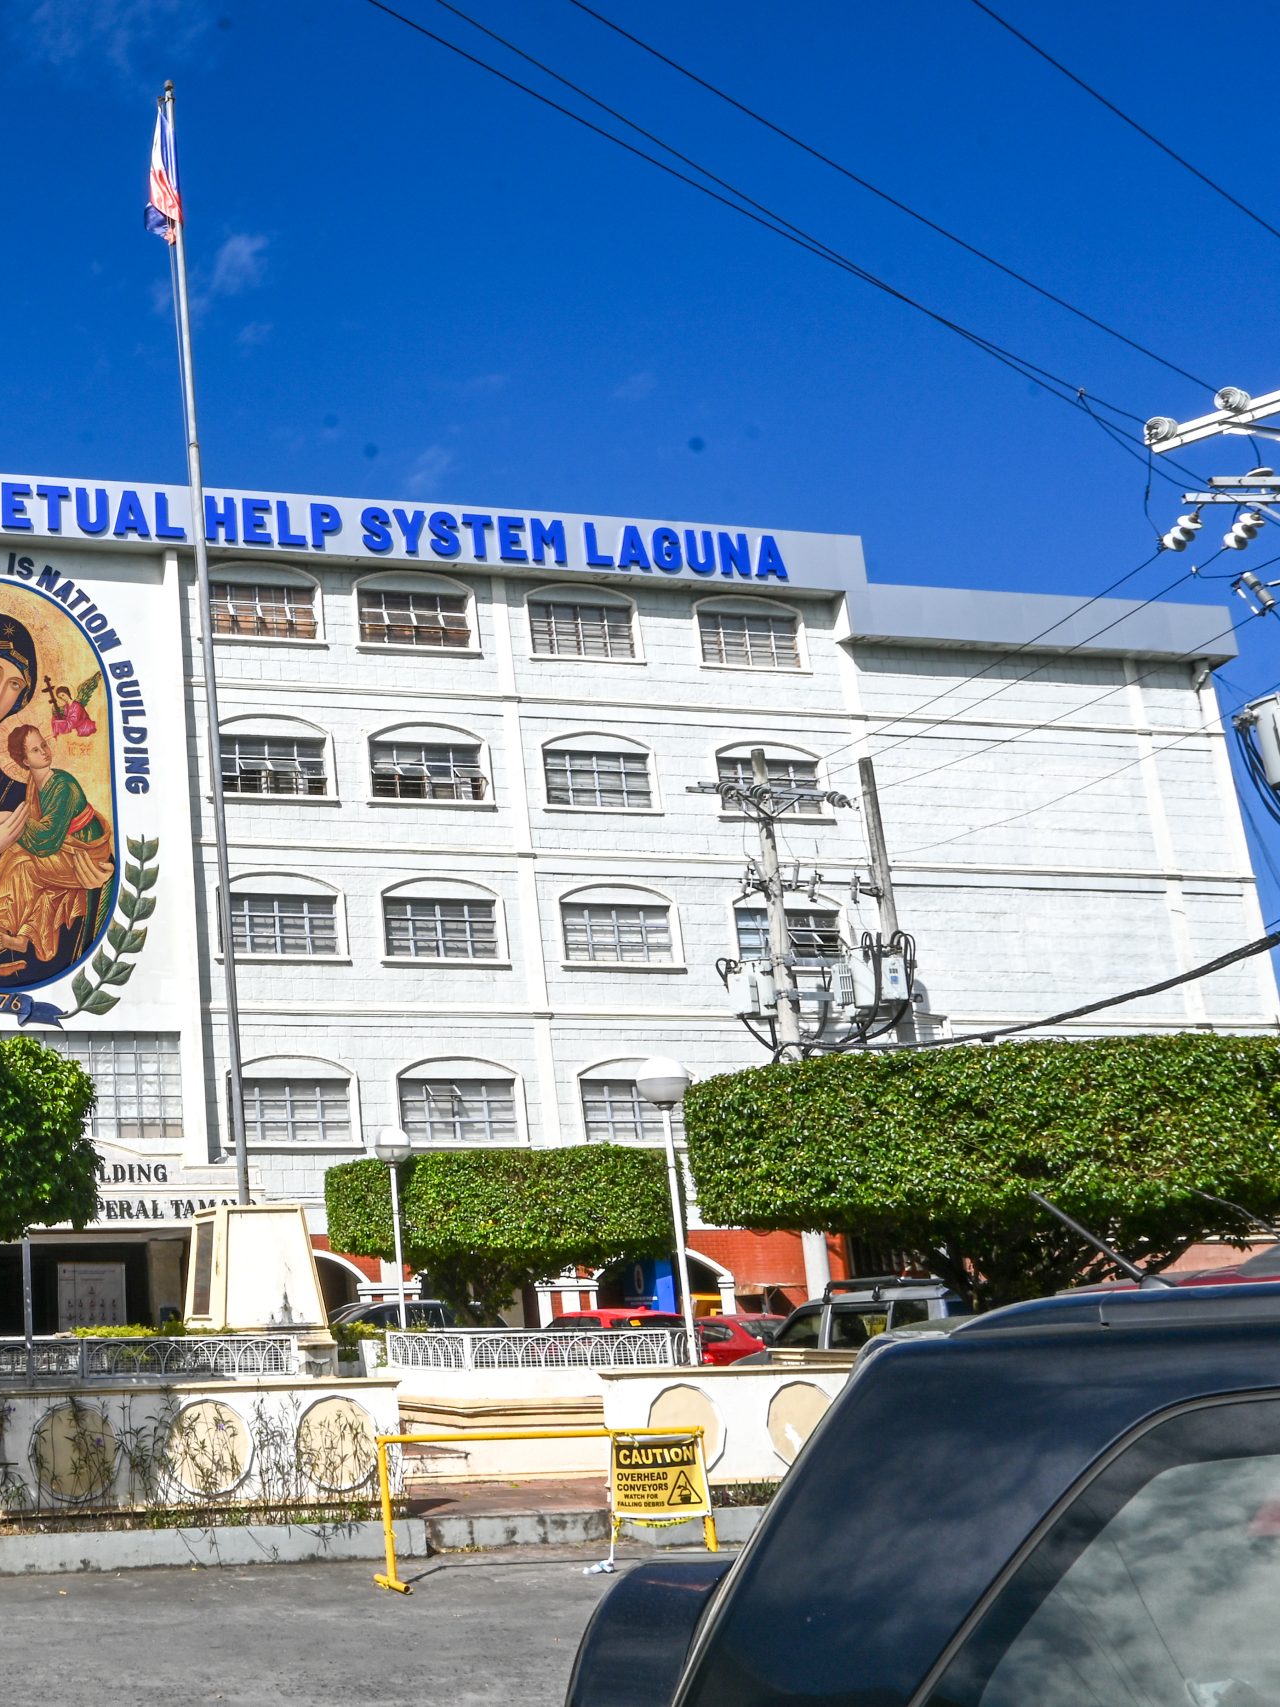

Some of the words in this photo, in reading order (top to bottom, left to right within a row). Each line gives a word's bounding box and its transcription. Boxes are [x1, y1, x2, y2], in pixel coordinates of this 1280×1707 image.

[204, 495, 342, 549] HELP
[360, 506, 568, 564] SYSTEM
[583, 522, 788, 579] LAGUNA
[7, 552, 35, 580] IS
[36, 565, 122, 653] NATION
[109, 659, 150, 796] BUILDING
[98, 1164, 168, 1183] LDING
[619, 1446, 693, 1465] CAUTION
[617, 1472, 668, 1481] OVERHEAD
[617, 1483, 669, 1492] CONVEYORS
